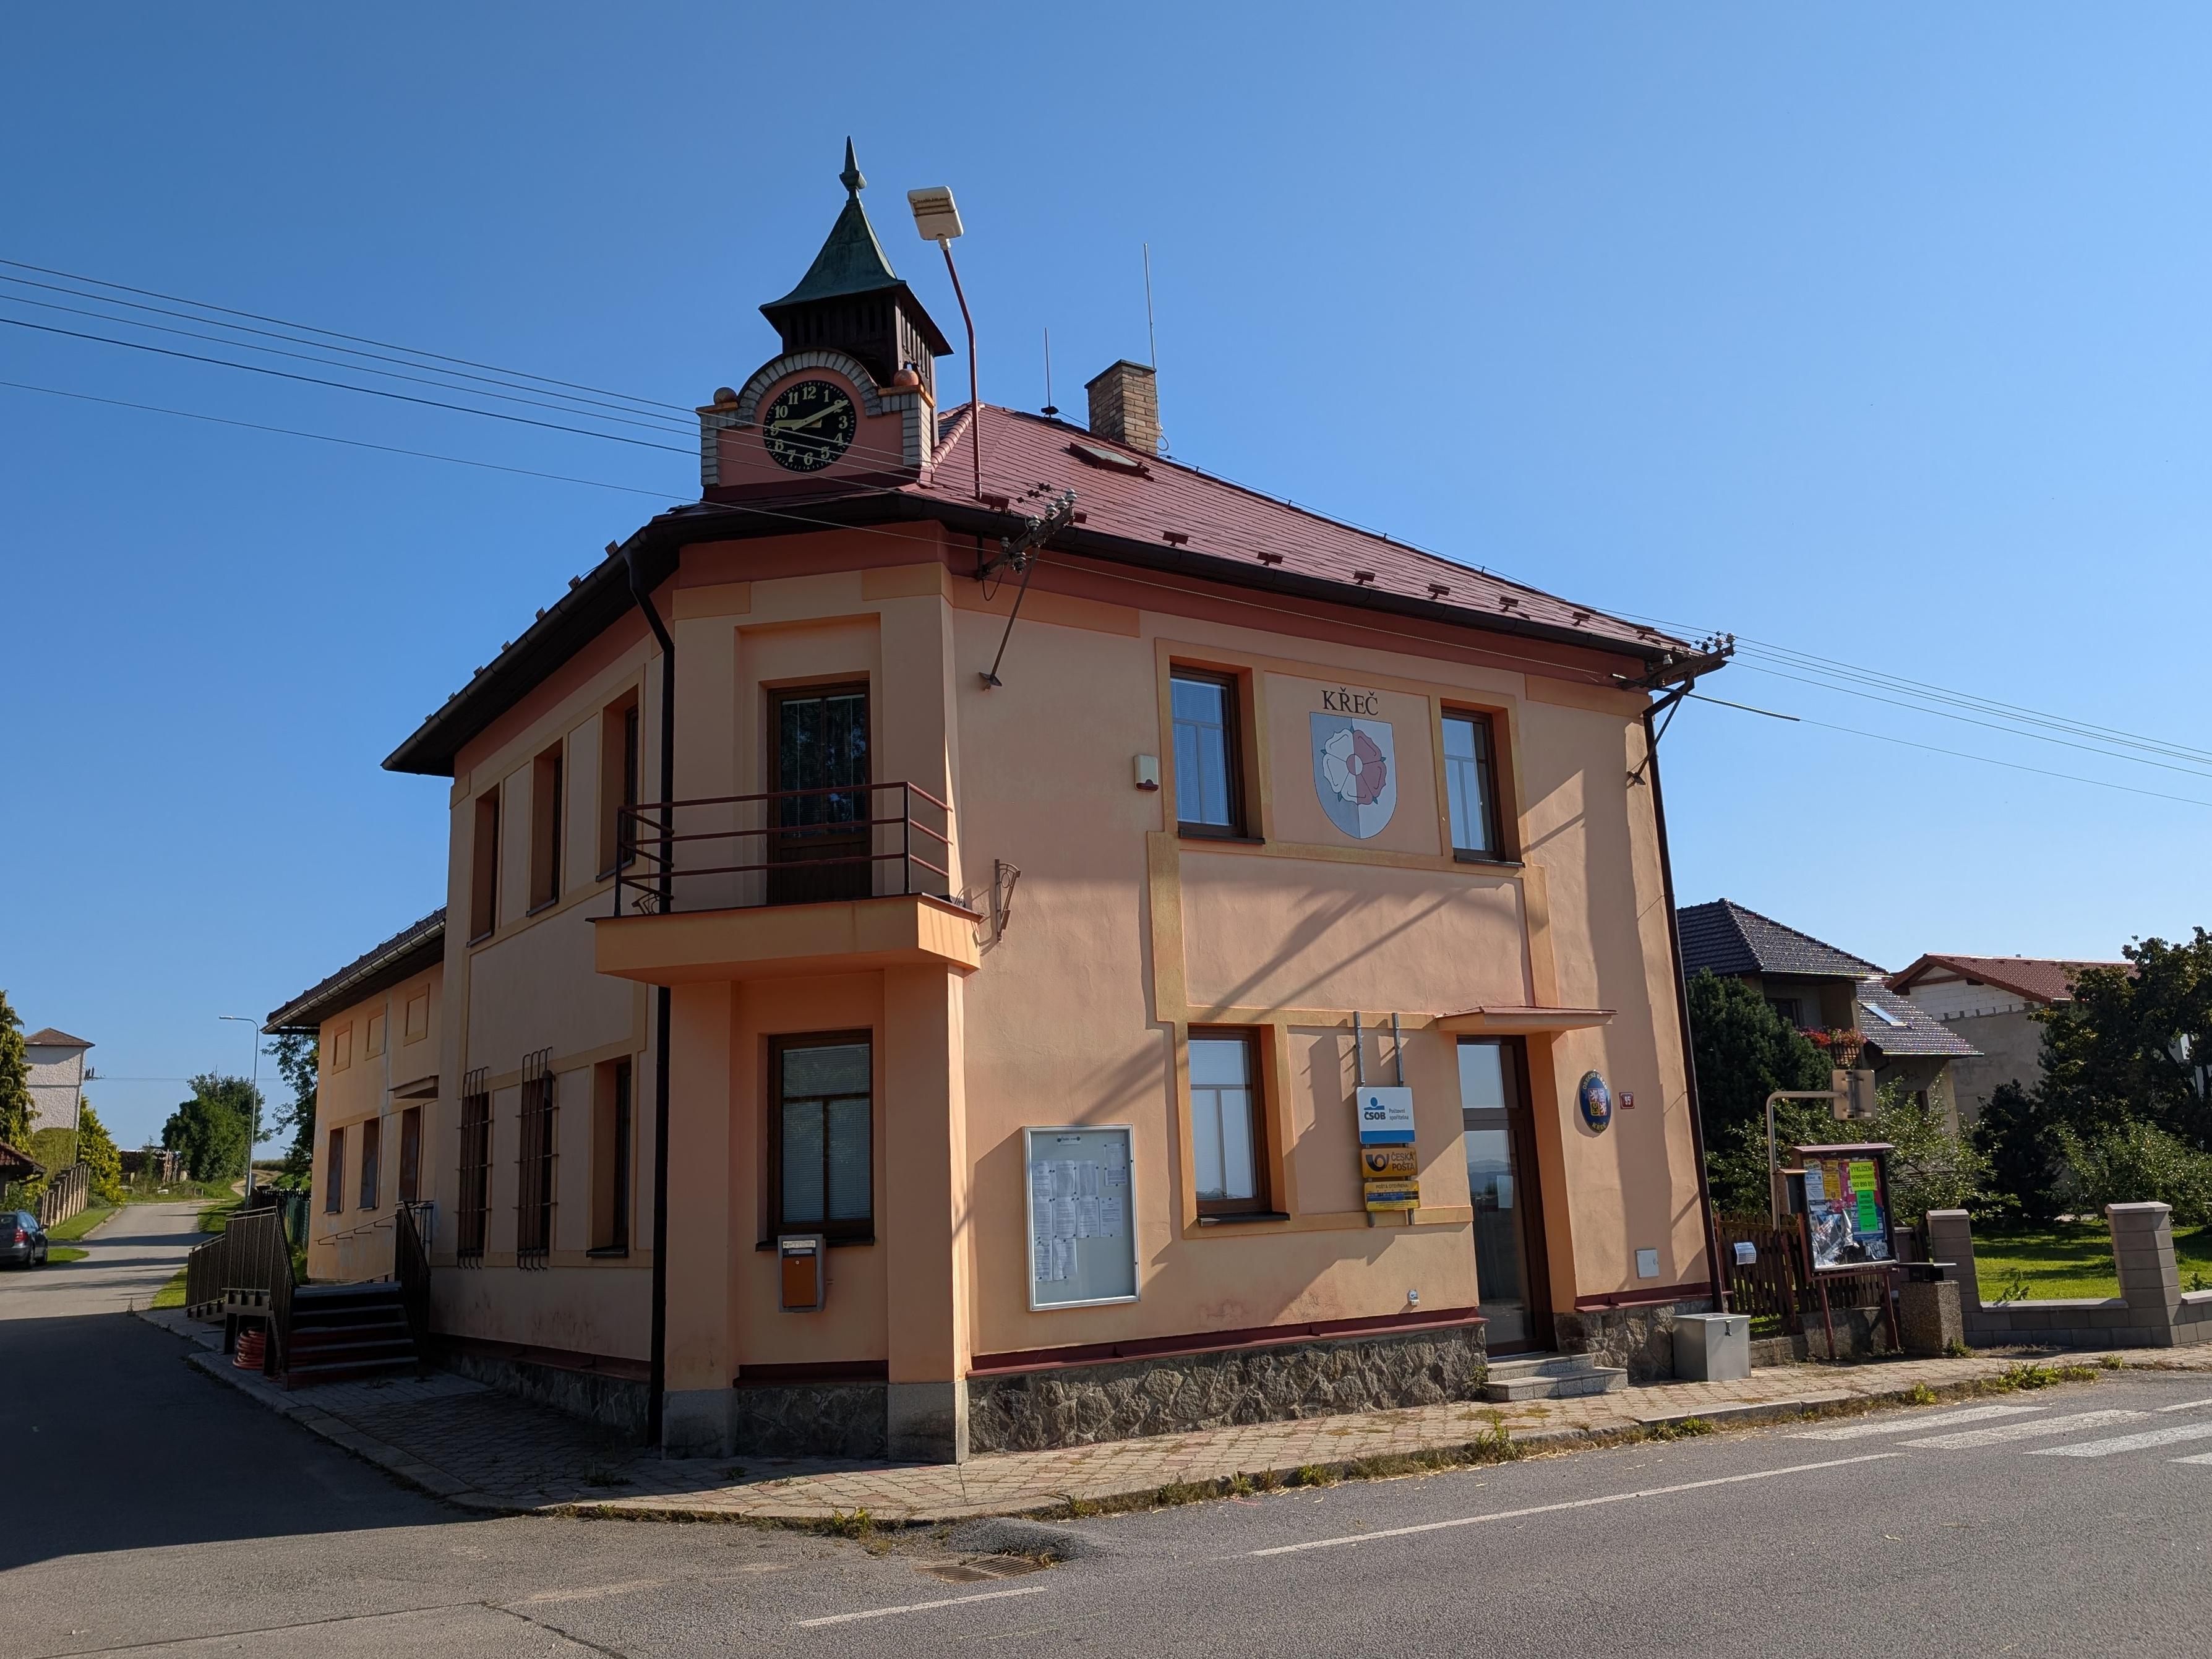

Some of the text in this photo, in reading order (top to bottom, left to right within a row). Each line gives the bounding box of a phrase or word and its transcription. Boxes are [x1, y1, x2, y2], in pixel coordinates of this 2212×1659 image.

[788, 392, 799, 405] 11
[802, 386, 817, 400] 12
[823, 390, 830, 402] 1
[774, 405, 789, 419] 10
[838, 415, 848, 429] 3
[774, 439, 784, 452] 8
[833, 432, 844, 446] 4
[787, 449, 796, 463] 7
[804, 452, 813, 465] 6
[821, 445, 830, 459] 5
[1321, 686, 1379, 716] KŘEČ
[1624, 1095, 1631, 1105] 95
[1364, 1111, 1386, 1120] ČSOB
[1391, 1151, 1415, 1162] ČESKÁ
[1392, 1161, 1415, 1172] POŠTA
